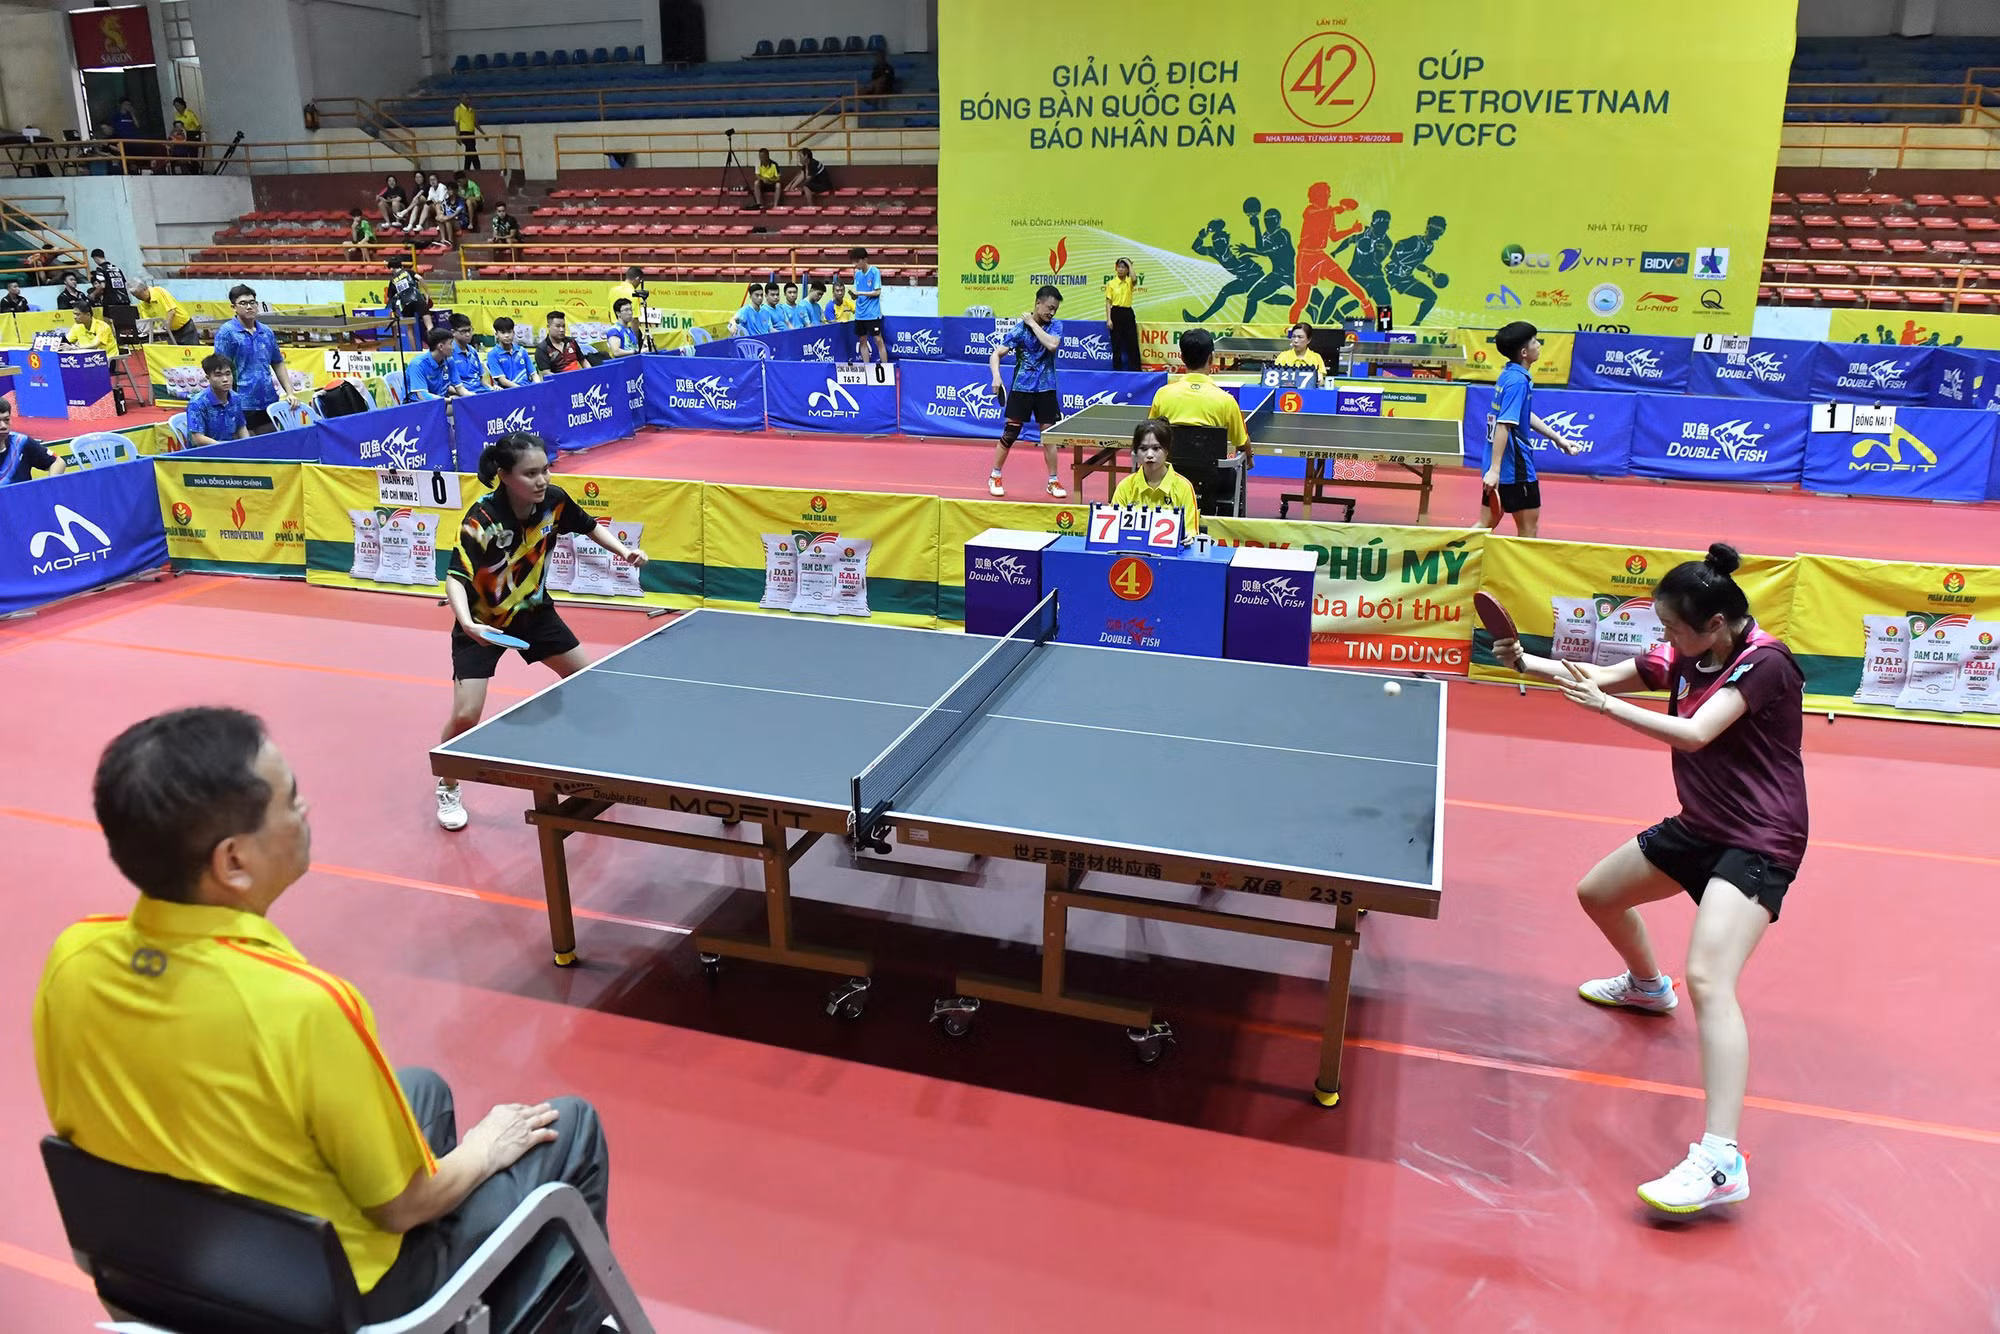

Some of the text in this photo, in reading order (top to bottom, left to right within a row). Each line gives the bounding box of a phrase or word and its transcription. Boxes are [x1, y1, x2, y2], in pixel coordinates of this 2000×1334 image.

[1053, 54, 1239, 90] GIẢI VÔ ĐỊCH
[1418, 49, 1484, 81] CÚP
[1290, 44, 1357, 106] 42
[960, 82, 1237, 121] BÓNG BÀN QUỐC GIA
[1415, 89, 1670, 115] PETROVIETNAM
[1030, 117, 1236, 150] BÁO NHÂN DÂN
[1265, 135, 1281, 143] NHA
[1413, 123, 1517, 147] PVCFC
[1583, 256, 1636, 267] VNPT
[1644, 259, 1675, 270] BIDV
[1001, 274, 1014, 284] MAU
[1030, 274, 1087, 285] PETROVIETNAM
[1635, 304, 1679, 313] LI-NING
[1141, 330, 1168, 344] NPK
[1703, 335, 1713, 350] 0
[1722, 340, 1748, 349] TIMES CITY
[892, 343, 943, 355] DOUBLE FISH
[1058, 349, 1087, 360] DOUBLE
[1142, 348, 1164, 358] Cho
[29, 353, 40, 368] 8
[332, 351, 341, 370] 2
[875, 365, 885, 383] 0
[1595, 364, 1663, 378] DOUBLE FISH
[1716, 366, 1785, 383] DOUBLE FISH
[1264, 371, 1280, 387] 8
[1298, 371, 1314, 388] 7
[1836, 375, 1908, 390] DOUBLE FISH
[669, 396, 737, 409] DOUBLE FISH
[1283, 393, 1297, 412] 5
[568, 407, 613, 428] DOUBLE FISH
[808, 409, 859, 419] MOFIT
[926, 403, 1002, 419] DOUBLE FISH
[1826, 404, 1836, 428] 1
[1874, 415, 1887, 427] NAI
[1888, 416, 1892, 427] 1
[1666, 442, 1768, 463] DOUBLE FISH
[407, 453, 427, 469] FISH
[1848, 462, 1937, 473] MOFIT
[399, 490, 413, 501] MINH
[414, 492, 418, 502] 2
[431, 475, 447, 505] 0
[282, 520, 299, 530] NPK
[1096, 514, 1116, 540] 7
[1152, 518, 1175, 545] 2
[220, 529, 264, 540] PETROVIETNAM
[275, 531, 294, 541] PHÚ
[1197, 538, 1208, 553] T
[33, 547, 112, 576] MOFIT
[553, 551, 572, 559] DAP
[1401, 540, 1469, 585] MỸ
[774, 568, 794, 576] DAP
[839, 572, 860, 580] KALI
[968, 570, 1032, 586] Double FISH
[1115, 561, 1140, 595] 4
[1234, 593, 1306, 609] Double FISH
[1312, 594, 1461, 623] ùa bội thu
[1099, 632, 1160, 648] DOUBLE FISH
[1563, 636, 1590, 646] DAP
[1344, 640, 1462, 665] TIN DÙNG
[1875, 656, 1902, 666] DAP
[1964, 661, 1995, 670] KALI
[1885, 666, 1903, 674] MAU
[593, 789, 625, 802] Double
[670, 795, 811, 828] MOFIT
[1013, 843, 1163, 879] 世乒赛器材供应商
[1309, 887, 1353, 905] 235
